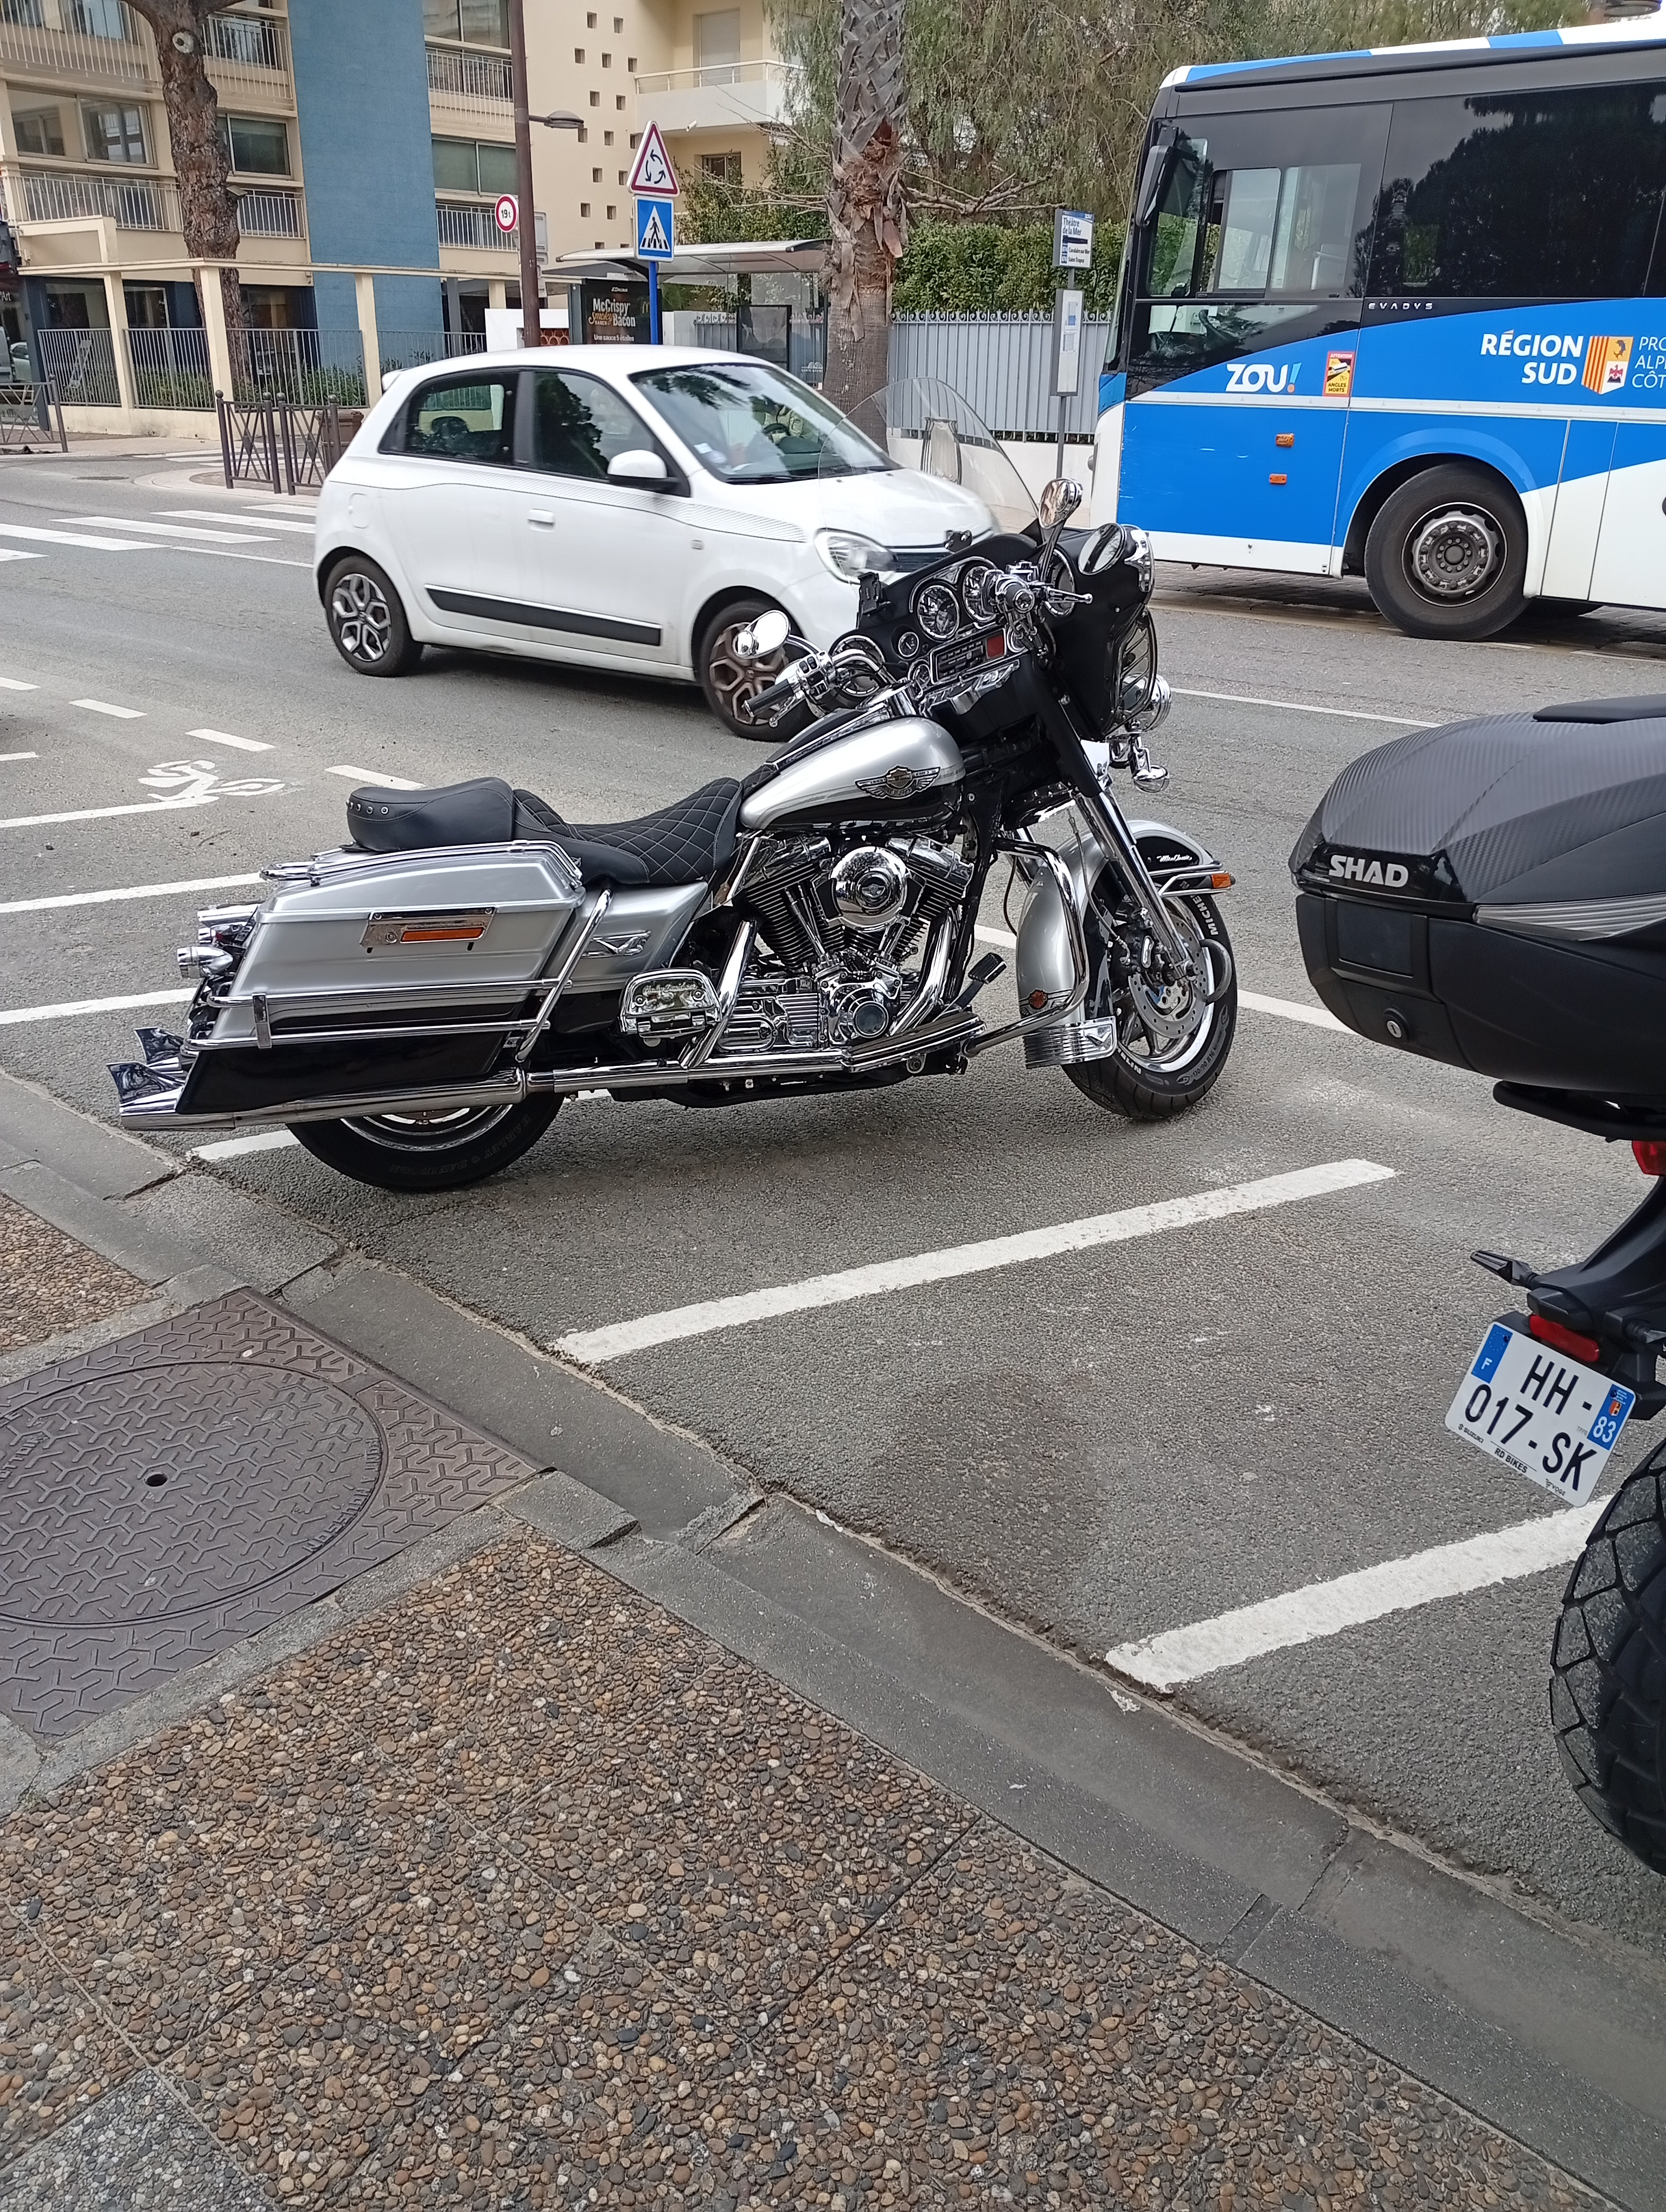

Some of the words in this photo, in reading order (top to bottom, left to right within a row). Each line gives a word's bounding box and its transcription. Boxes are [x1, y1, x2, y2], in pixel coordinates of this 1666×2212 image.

[1063, 217, 1080, 227] Théâtre
[593, 298, 629, 316] McCrispy
[588, 311, 613, 325] Smoky
[613, 313, 636, 327] Bacon
[1481, 329, 1584, 357] RÉGION
[1225, 363, 1302, 393] ZOU!
[1521, 362, 1578, 385] SUD
[1329, 854, 1409, 888] SHAD
[1481, 1358, 1492, 1370] F
[1463, 1427, 1484, 1443] SUZUKI
[1593, 1416, 1616, 1443] 83
[1494, 1448, 1505, 1459] RD
[1505, 1454, 1528, 1474] BIKES
[1550, 1483, 1567, 1497] VOGE
